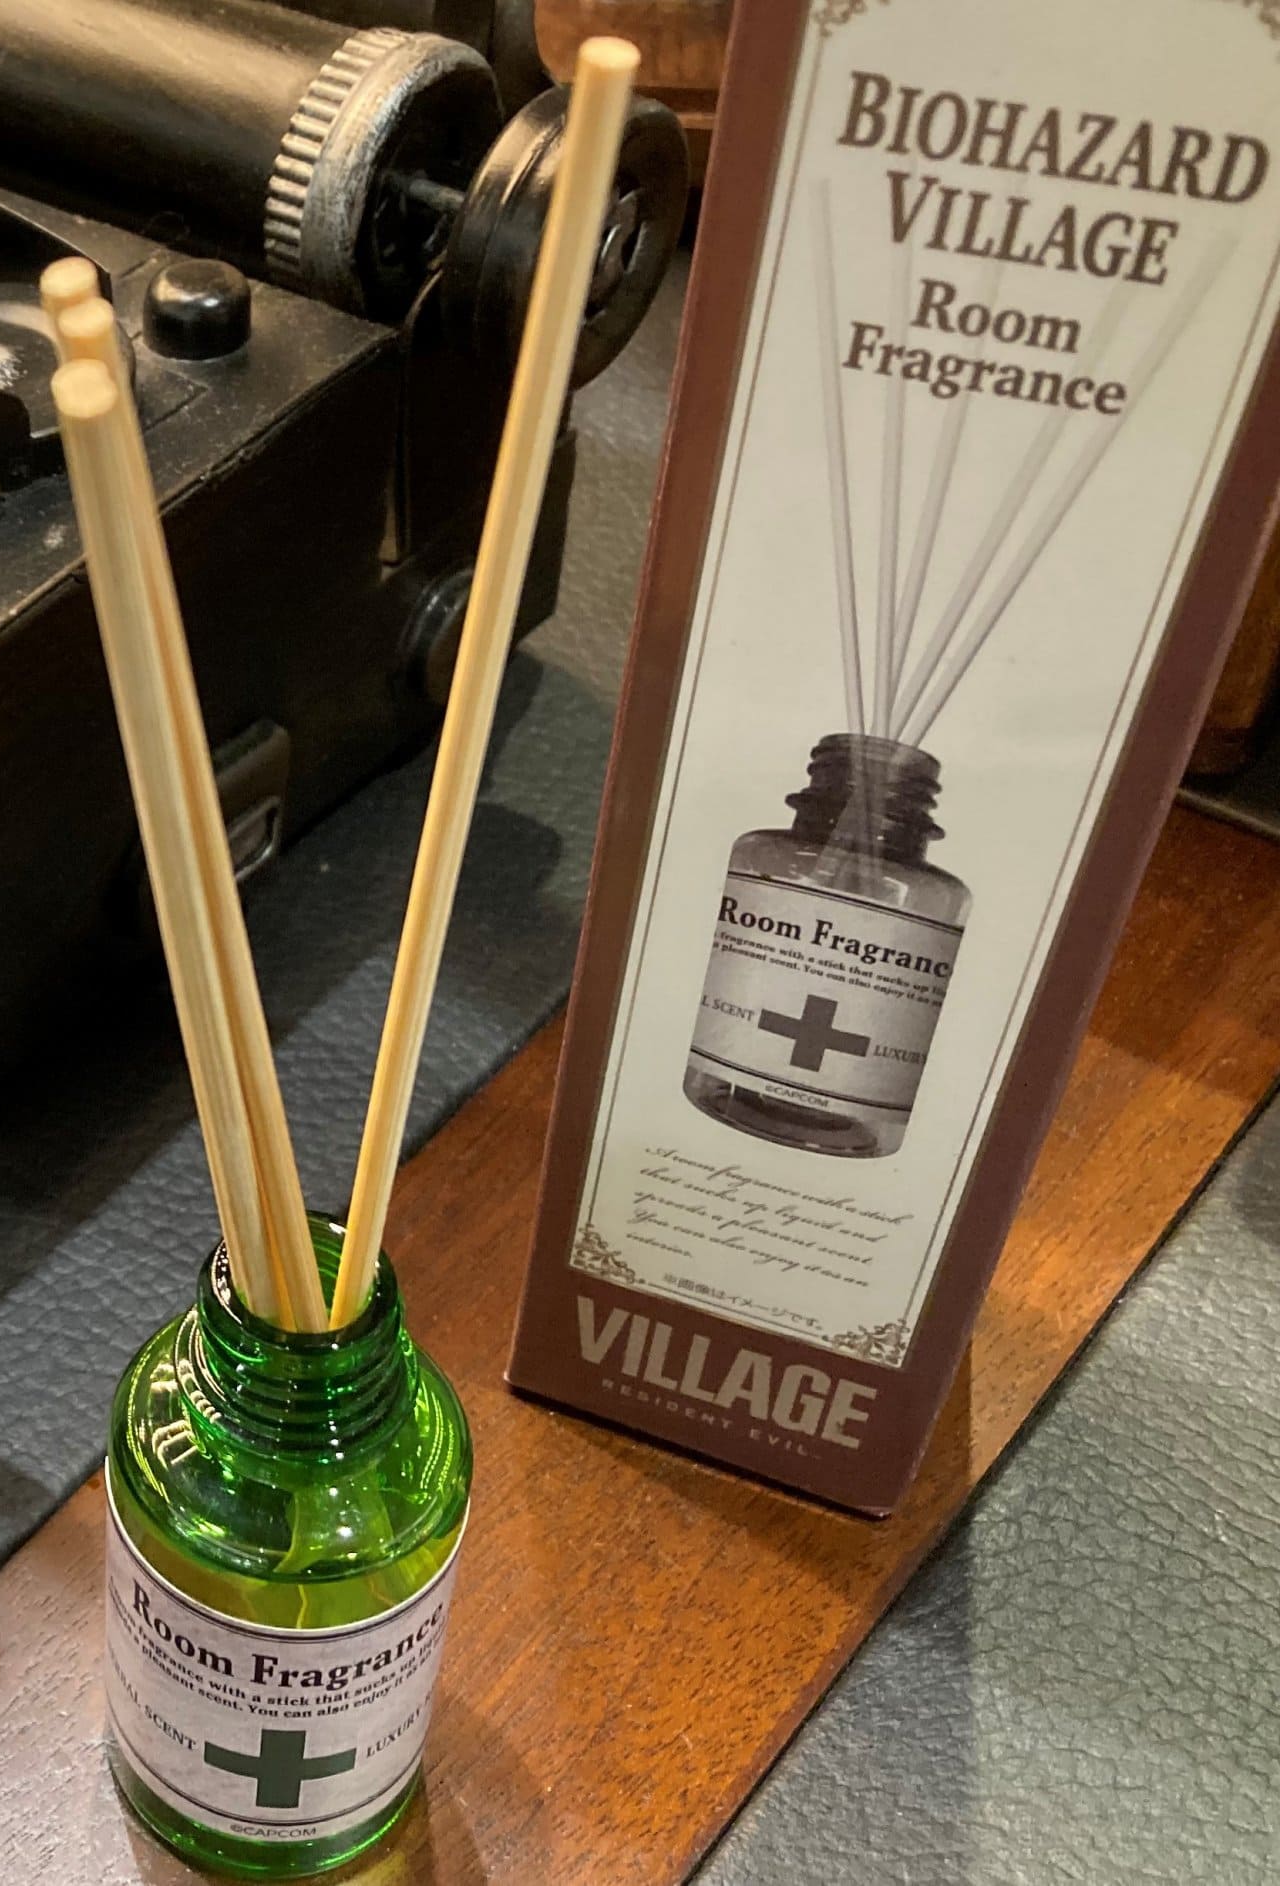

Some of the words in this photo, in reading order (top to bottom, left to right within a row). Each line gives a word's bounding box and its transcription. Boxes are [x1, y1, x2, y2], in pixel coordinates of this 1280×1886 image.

[837, 70, 1270, 203] BIOHAZARD
[886, 170, 1180, 286] VILLAGE
[910, 278, 1082, 354] Room
[841, 320, 1128, 415] Fragrance
[717, 896, 802, 941] Room
[810, 919, 954, 979] Fragranc
[711, 999, 756, 1022] SCENT
[576, 1295, 878, 1450] VILLAGE
[601, 1378, 733, 1430] RESIDENT
[749, 1429, 808, 1457] EVIL
[132, 1577, 235, 1678] Room
[249, 1603, 444, 1691] Fragrance
[142, 1646, 195, 1691] pleasant
[248, 1704, 279, 1717] You
[283, 1708, 312, 1719] can
[316, 1704, 349, 1717] also
[353, 1685, 393, 1708] enjoy
[208, 1679, 245, 1699] with
[252, 1695, 261, 1703] a
[267, 1695, 310, 1706] stick
[316, 1691, 350, 1705] that
[354, 1672, 396, 1697] sucks
[144, 1704, 197, 1751] SCENT
[230, 1823, 318, 1838] ©CAPCOM
